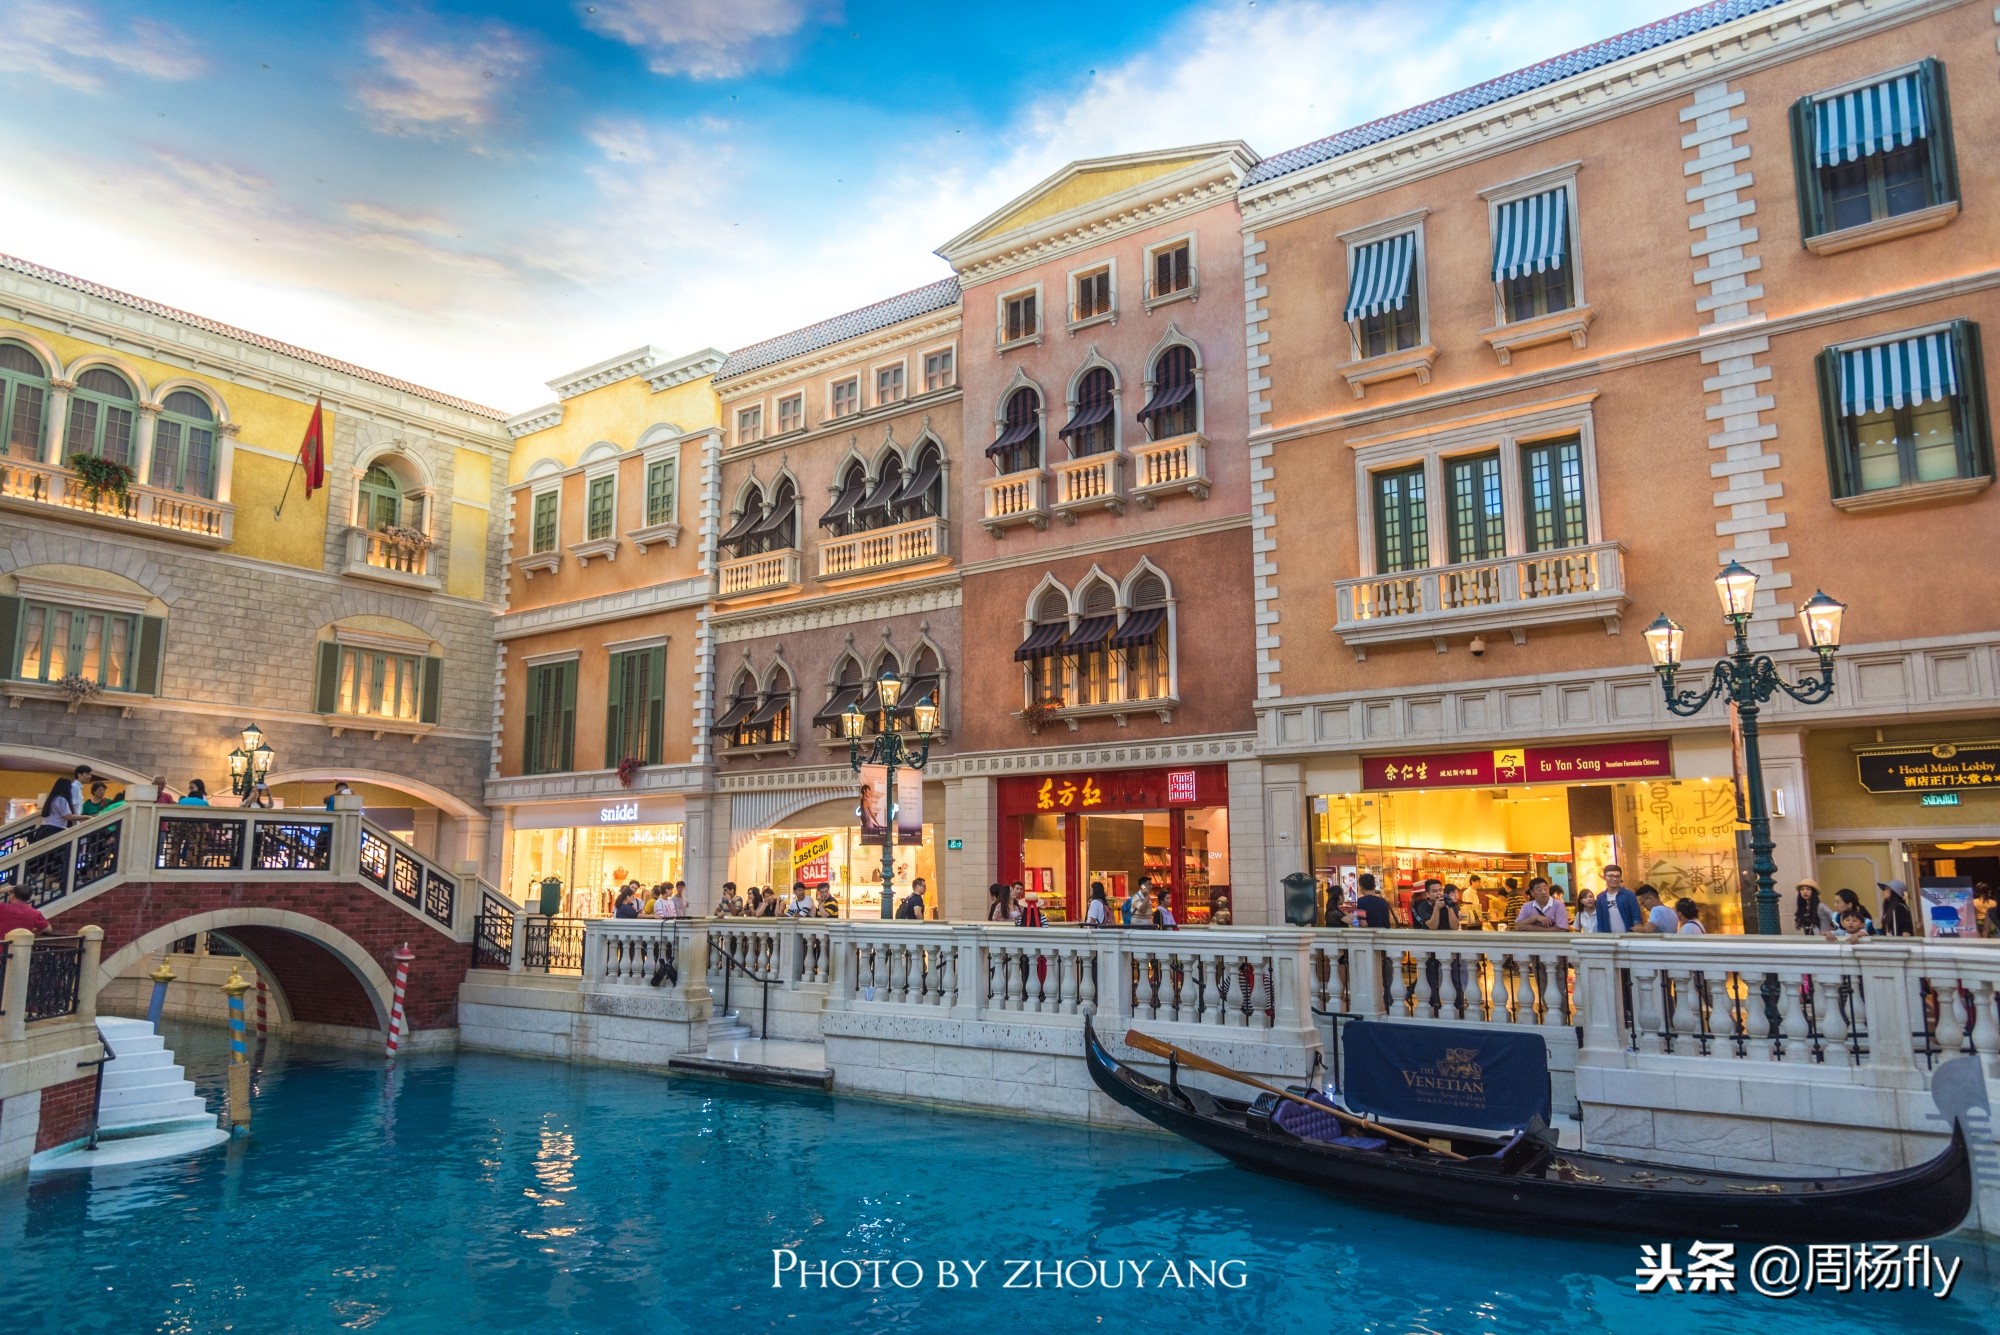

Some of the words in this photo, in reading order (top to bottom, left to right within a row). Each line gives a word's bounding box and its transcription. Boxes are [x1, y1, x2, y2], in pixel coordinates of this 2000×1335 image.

[1540, 760, 1552, 772] Eu
[1555, 759, 1572, 771] Yan
[1576, 758, 1600, 772] Sang
[1899, 764, 1928, 774] Hotel
[1930, 763, 1959, 773] Main
[1961, 761, 1996, 772] Lobby
[1904, 773, 1981, 787] 酒店正门大堂
[600, 802, 639, 821] snidel
[1669, 822, 1706, 837] dang
[1711, 821, 1734, 837] gui
[793, 848, 812, 865] Last
[812, 839, 829, 855] Call
[803, 864, 827, 880] SALE
[1402, 1070, 1484, 1093] VENETIAN
